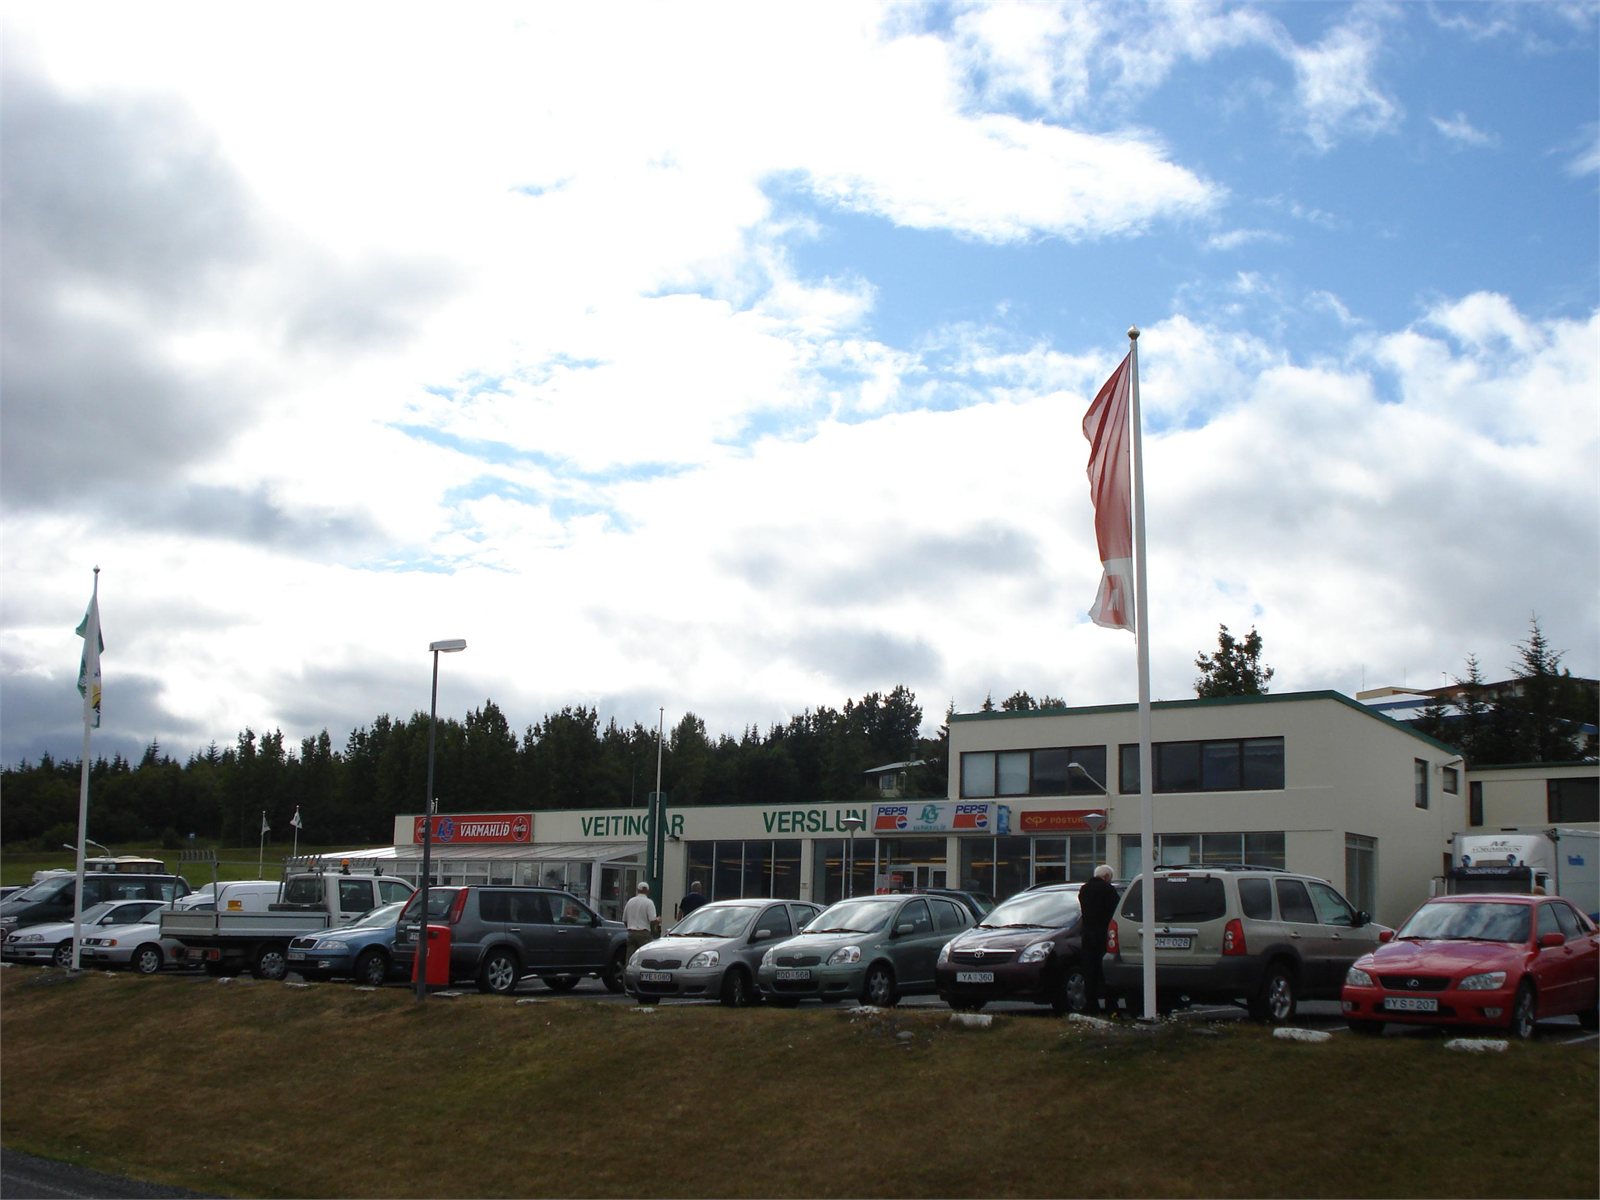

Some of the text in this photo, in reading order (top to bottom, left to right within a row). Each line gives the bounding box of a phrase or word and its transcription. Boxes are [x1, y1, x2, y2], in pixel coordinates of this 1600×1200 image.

[877, 806, 908, 816] PEPSI
[955, 804, 988, 814] PEPSI
[763, 809, 867, 833] VERSLUN
[962, 973, 992, 982] YA 360
[1391, 999, 1435, 1010] YS 207
